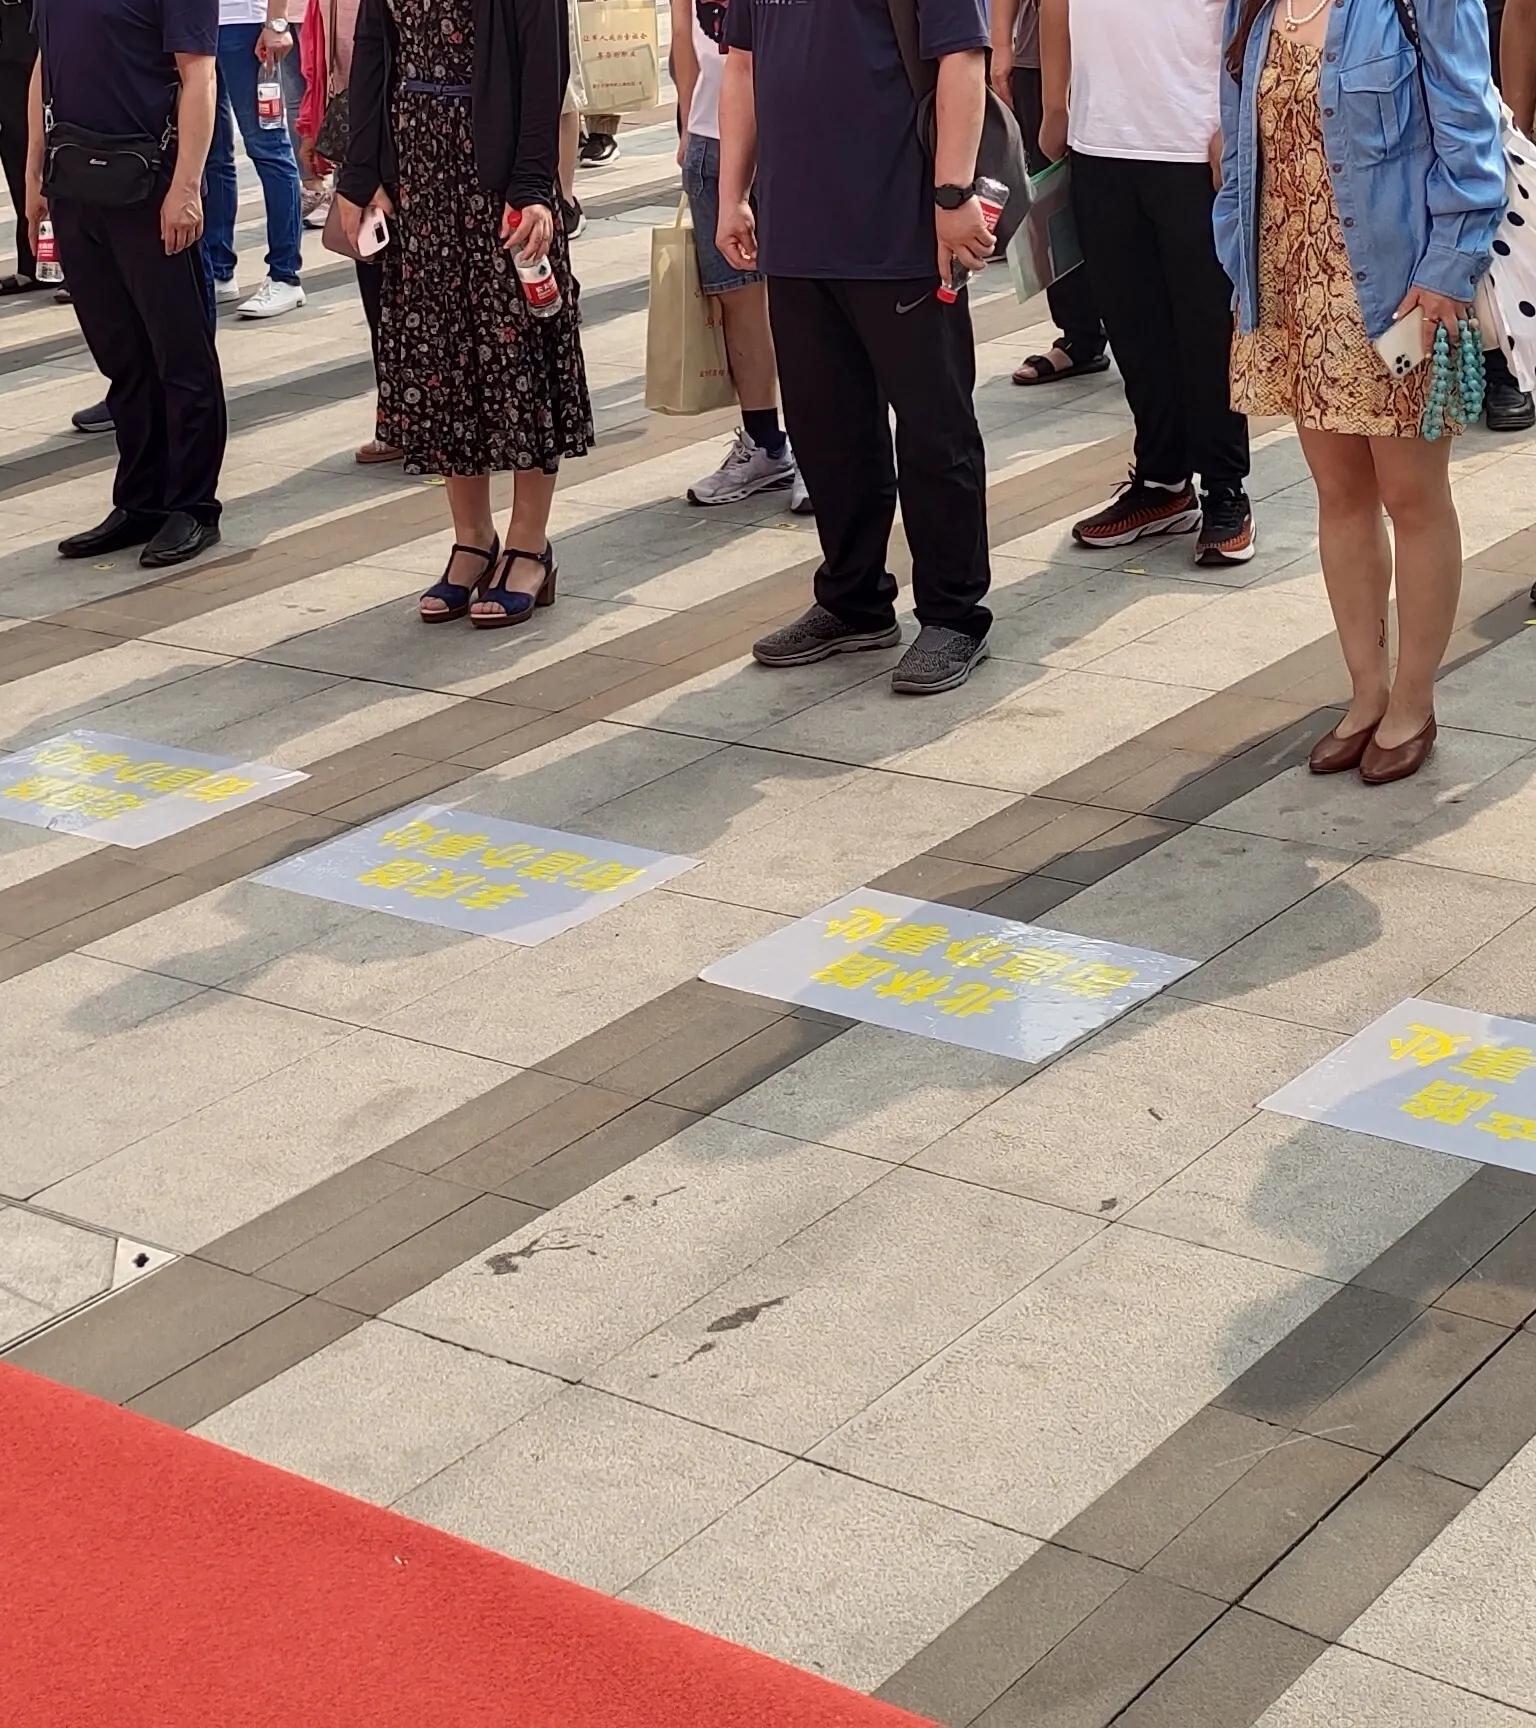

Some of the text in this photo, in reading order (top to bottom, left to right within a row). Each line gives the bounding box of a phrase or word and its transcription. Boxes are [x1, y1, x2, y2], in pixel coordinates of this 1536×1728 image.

[809, 953, 1014, 1018] 北林路
[823, 908, 1138, 999] 街道办事处
